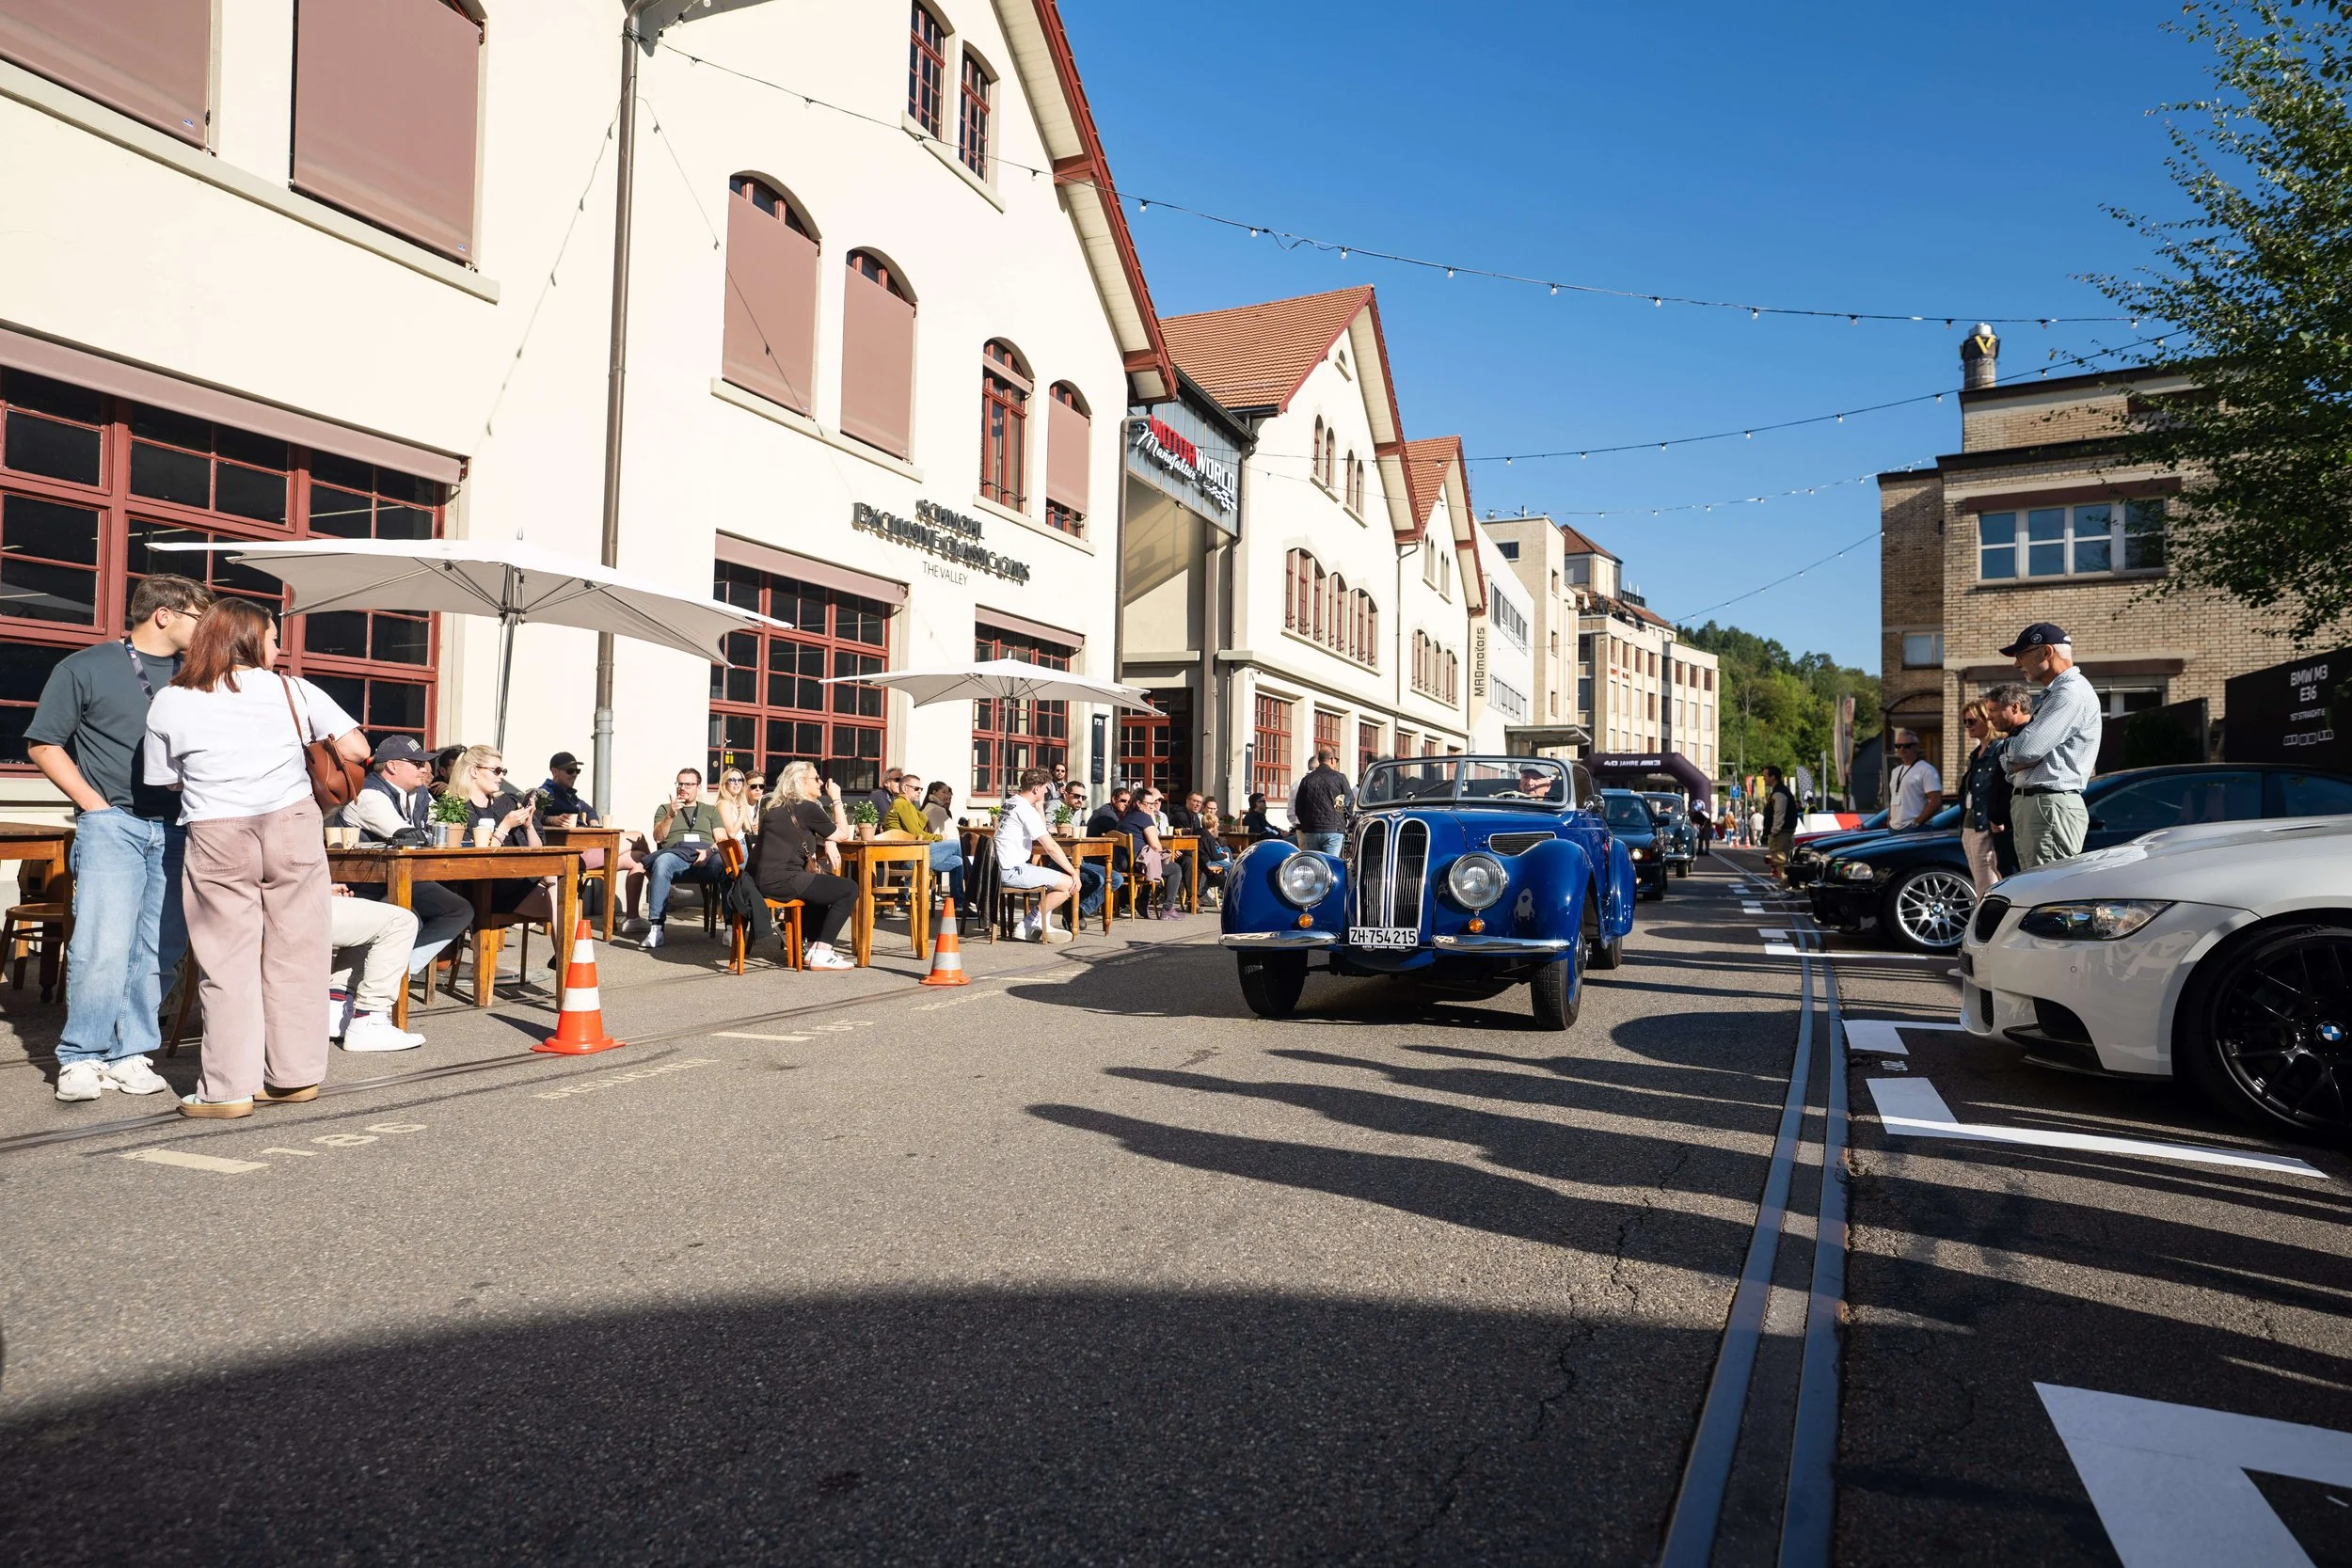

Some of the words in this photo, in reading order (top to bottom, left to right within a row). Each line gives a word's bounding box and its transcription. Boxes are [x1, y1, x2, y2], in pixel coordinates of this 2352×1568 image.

[1136, 421, 1197, 481] Manufaktur
[852, 501, 942, 549] EXCLUSIVE
[939, 535, 997, 570] CLASSIC
[997, 556, 1031, 582] CARS
[922, 561, 939, 578] THE
[939, 566, 969, 586] VALLEY
[2290, 669, 2312, 687] BMW
[2313, 664, 2328, 681] M3
[2299, 686, 2317, 702] E36
[1393, 930, 1416, 944] 215
[530, 1058, 721, 1100] BESUCHER
[260, 1121, 429, 1157] 186
